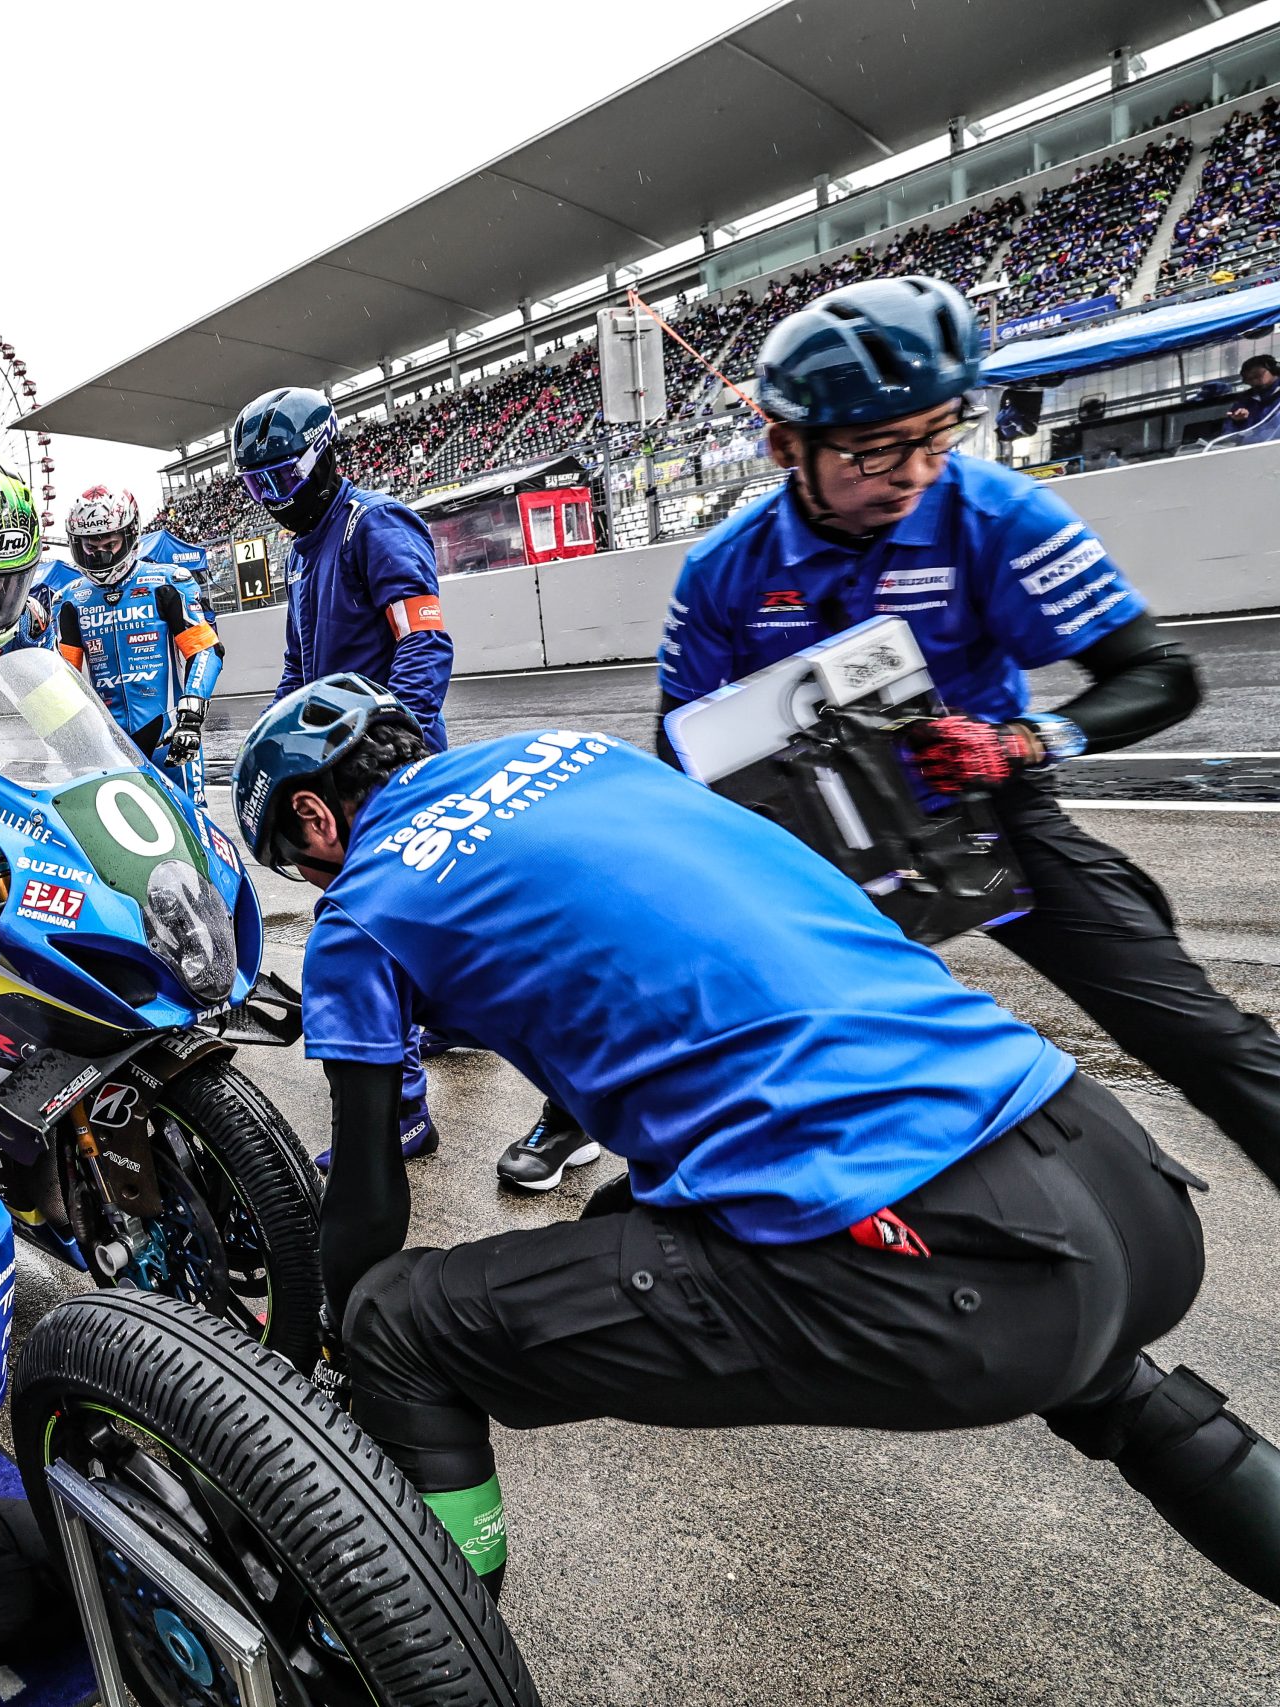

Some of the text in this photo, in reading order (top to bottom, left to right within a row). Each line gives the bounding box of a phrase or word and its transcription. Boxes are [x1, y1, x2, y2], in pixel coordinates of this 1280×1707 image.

[78, 520, 110, 529] SHARK
[243, 543, 256, 560] 21
[77, 605, 106, 616] Team
[80, 604, 154, 630] SUZUKI
[128, 633, 159, 643] MOTUL
[95, 779, 176, 858] 0
[373, 793, 468, 855] Team
[457, 825, 492, 855] CN
[16, 856, 95, 885] SUZUKI
[16, 906, 77, 931] YOSHIMURA
[196, 1000, 232, 1024] PIAA
